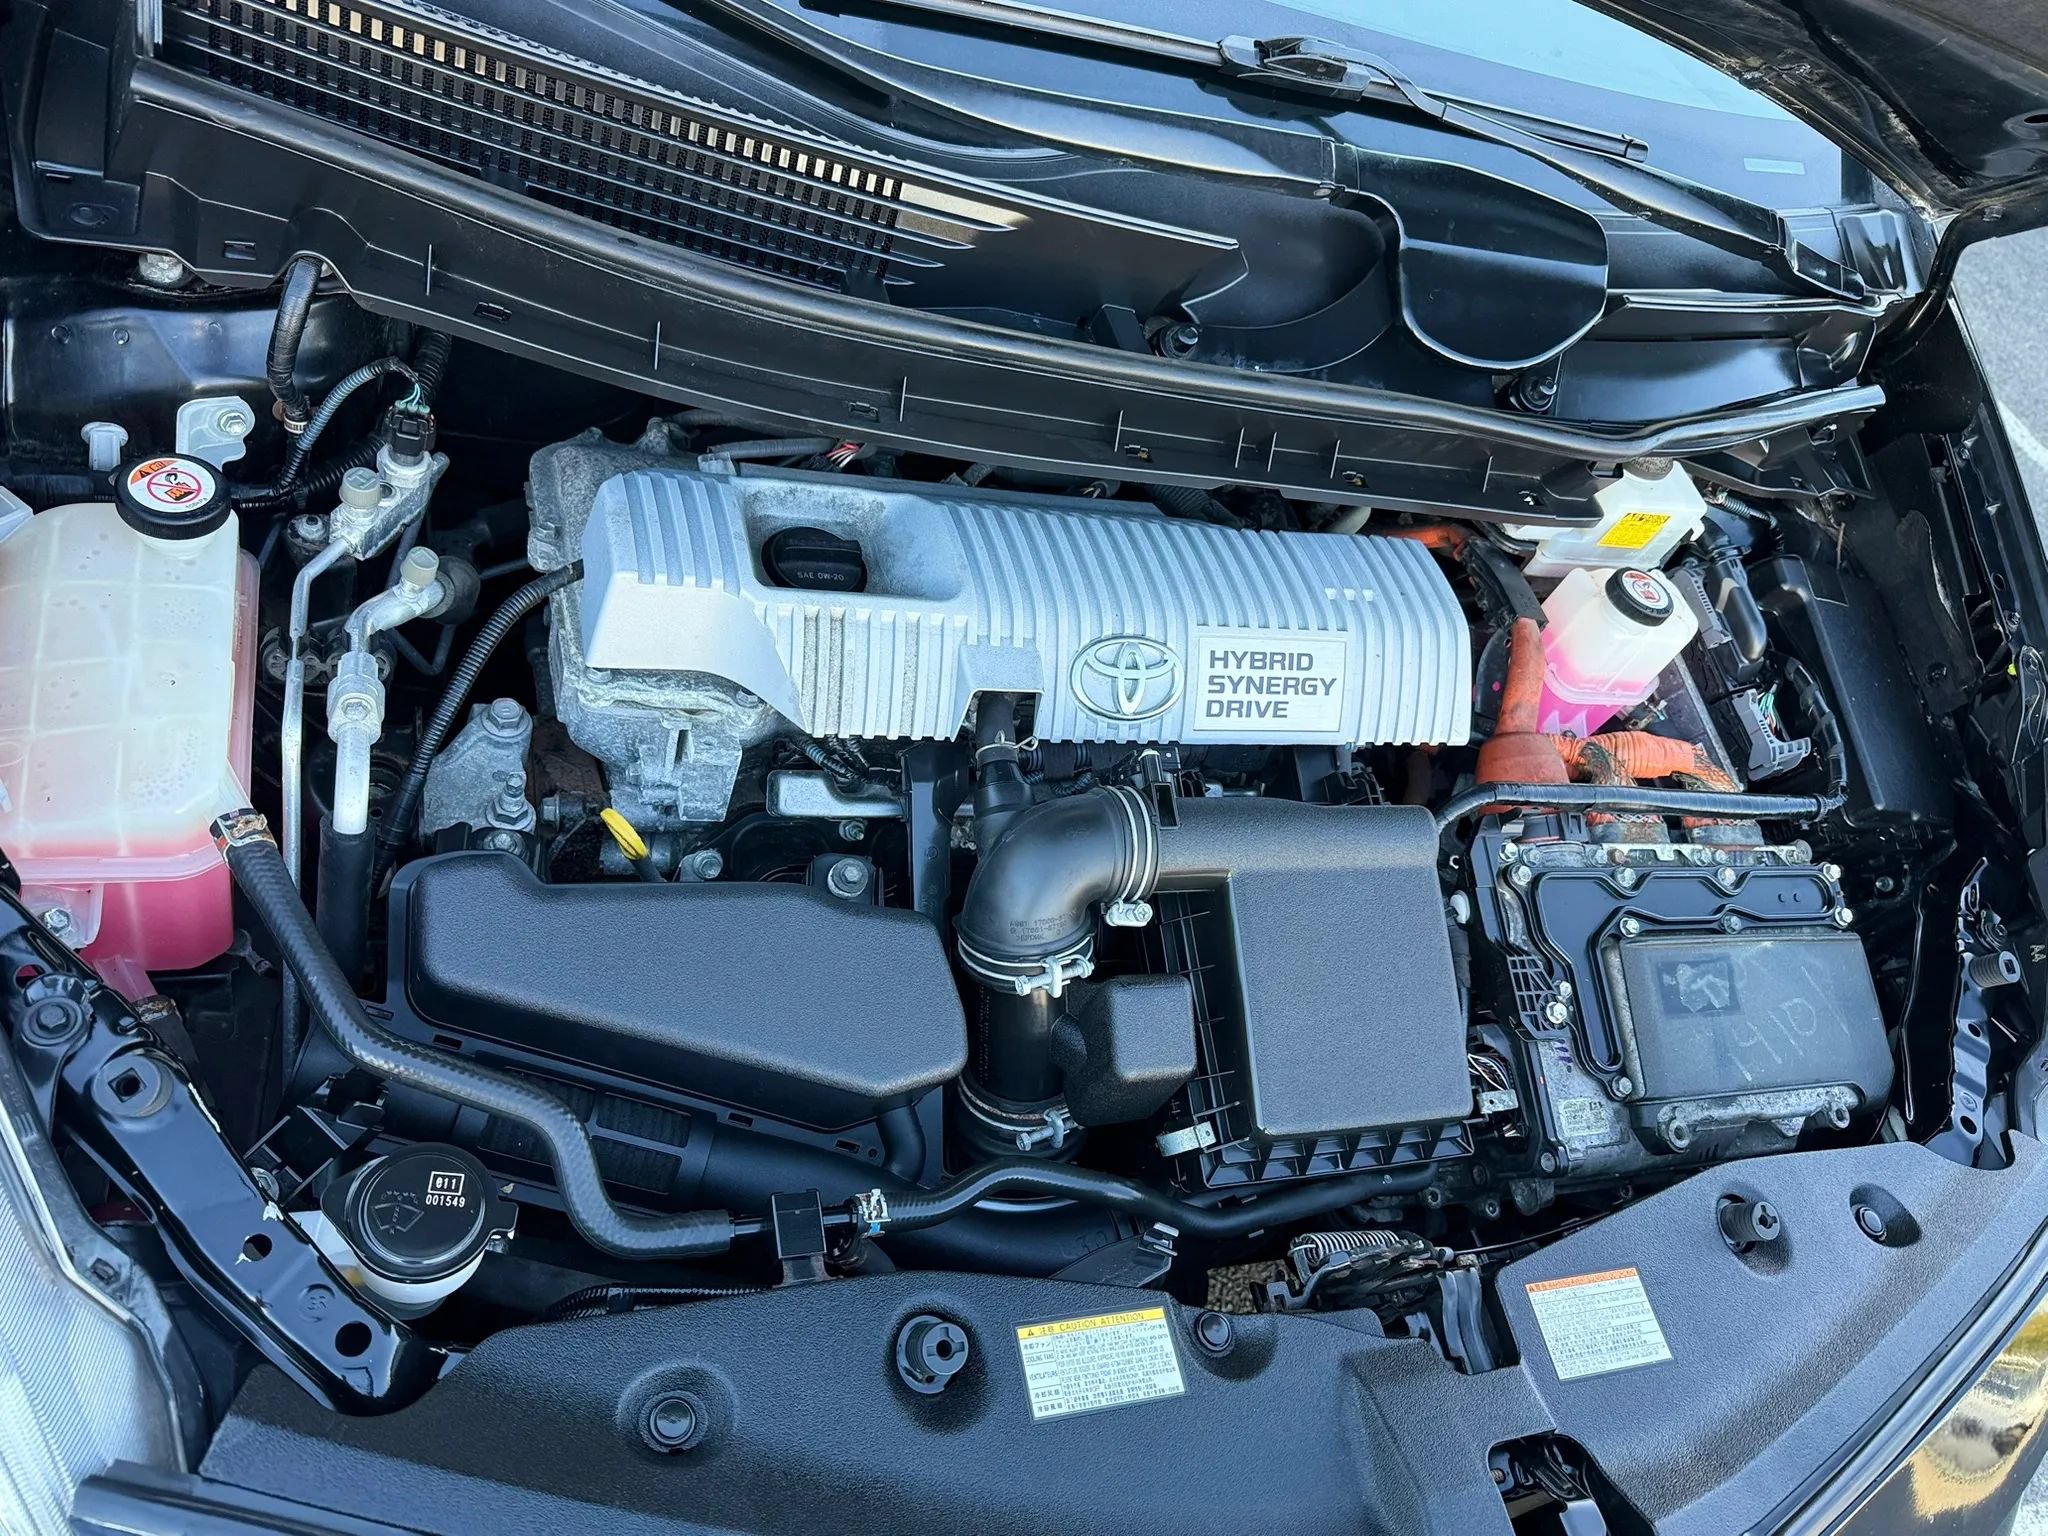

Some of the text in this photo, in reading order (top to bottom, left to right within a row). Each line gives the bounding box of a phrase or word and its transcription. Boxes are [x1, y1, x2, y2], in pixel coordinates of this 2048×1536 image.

[817, 572, 845, 581] 0W-20
[1209, 649, 1314, 671] HYBRID
[1207, 675, 1337, 696] SYNERGY
[1205, 700, 1289, 718] DRIVE
[435, 1176, 457, 1190] e11
[425, 1194, 466, 1208] 001549
[1059, 1320, 1097, 1332] CAUTION
[1100, 1313, 1145, 1325] ATTENTION
